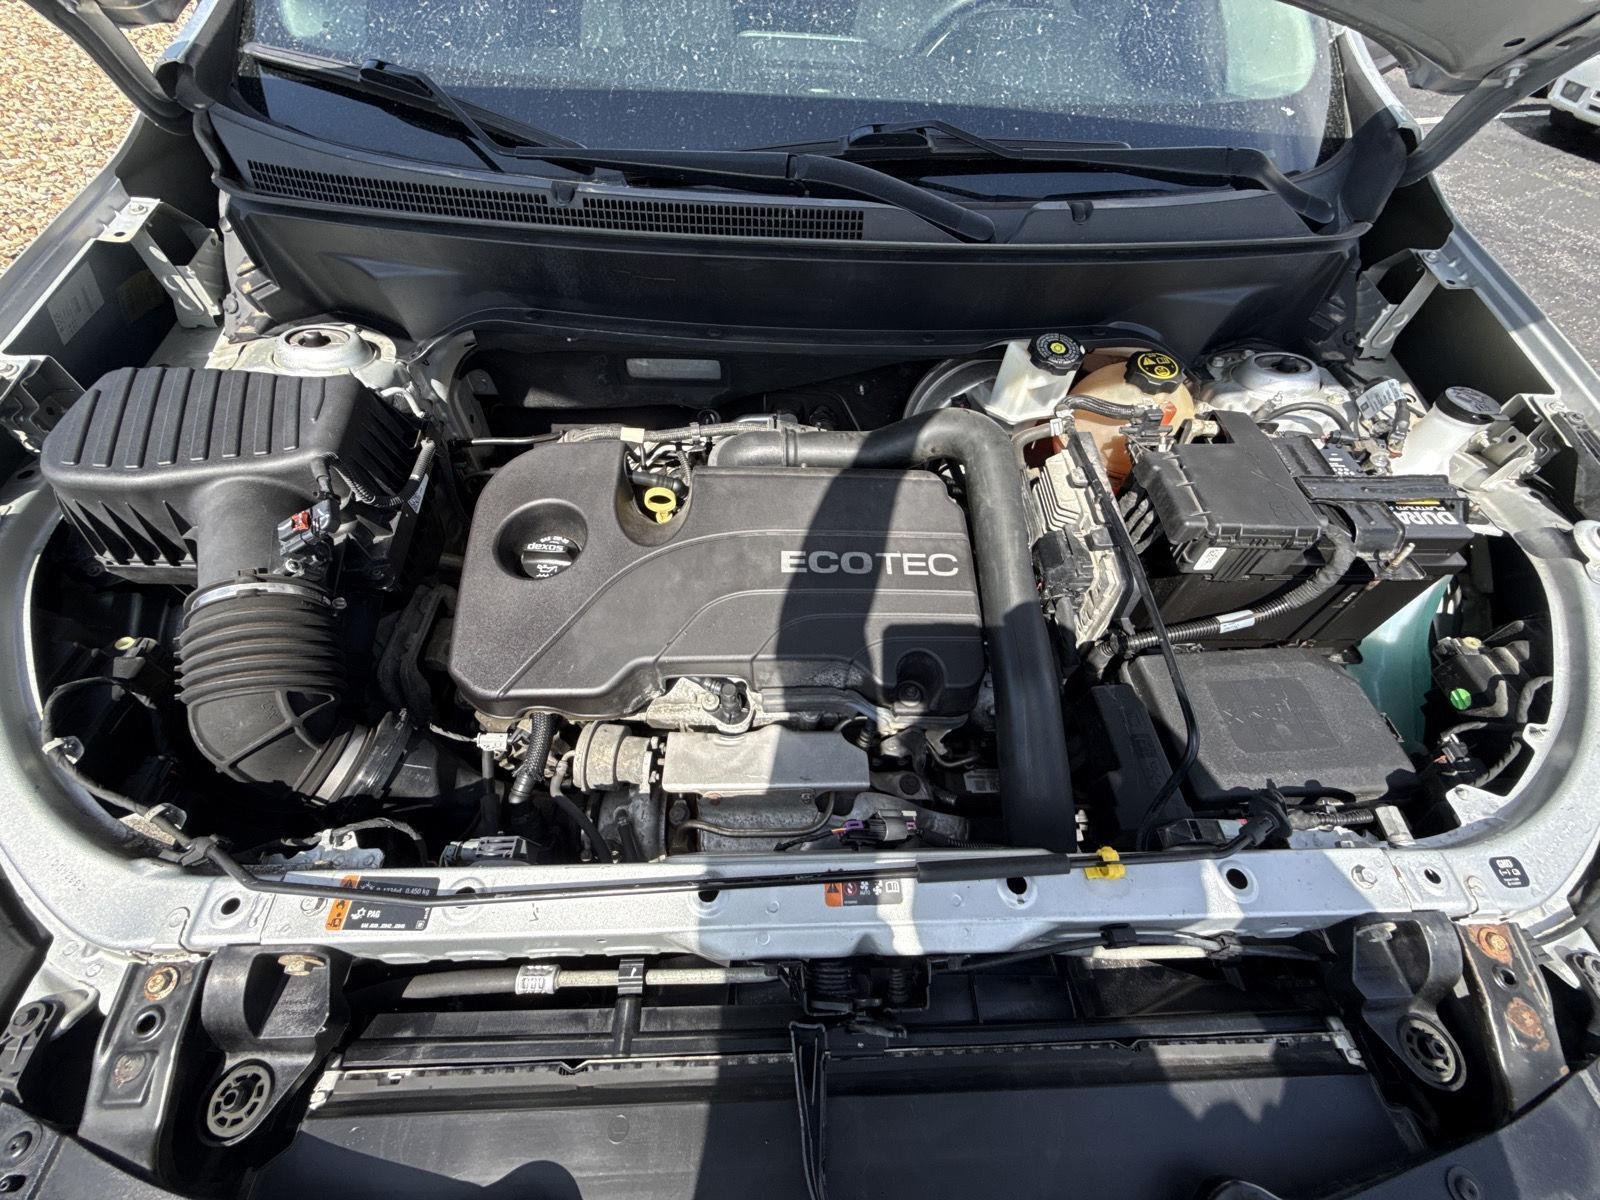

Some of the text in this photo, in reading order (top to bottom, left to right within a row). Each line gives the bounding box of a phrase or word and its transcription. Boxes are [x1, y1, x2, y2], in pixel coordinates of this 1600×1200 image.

[527, 542, 564, 552] dexos
[780, 550, 959, 577] ECOTEC
[421, 888, 430, 896] kg
[367, 909, 381, 919] PAG
